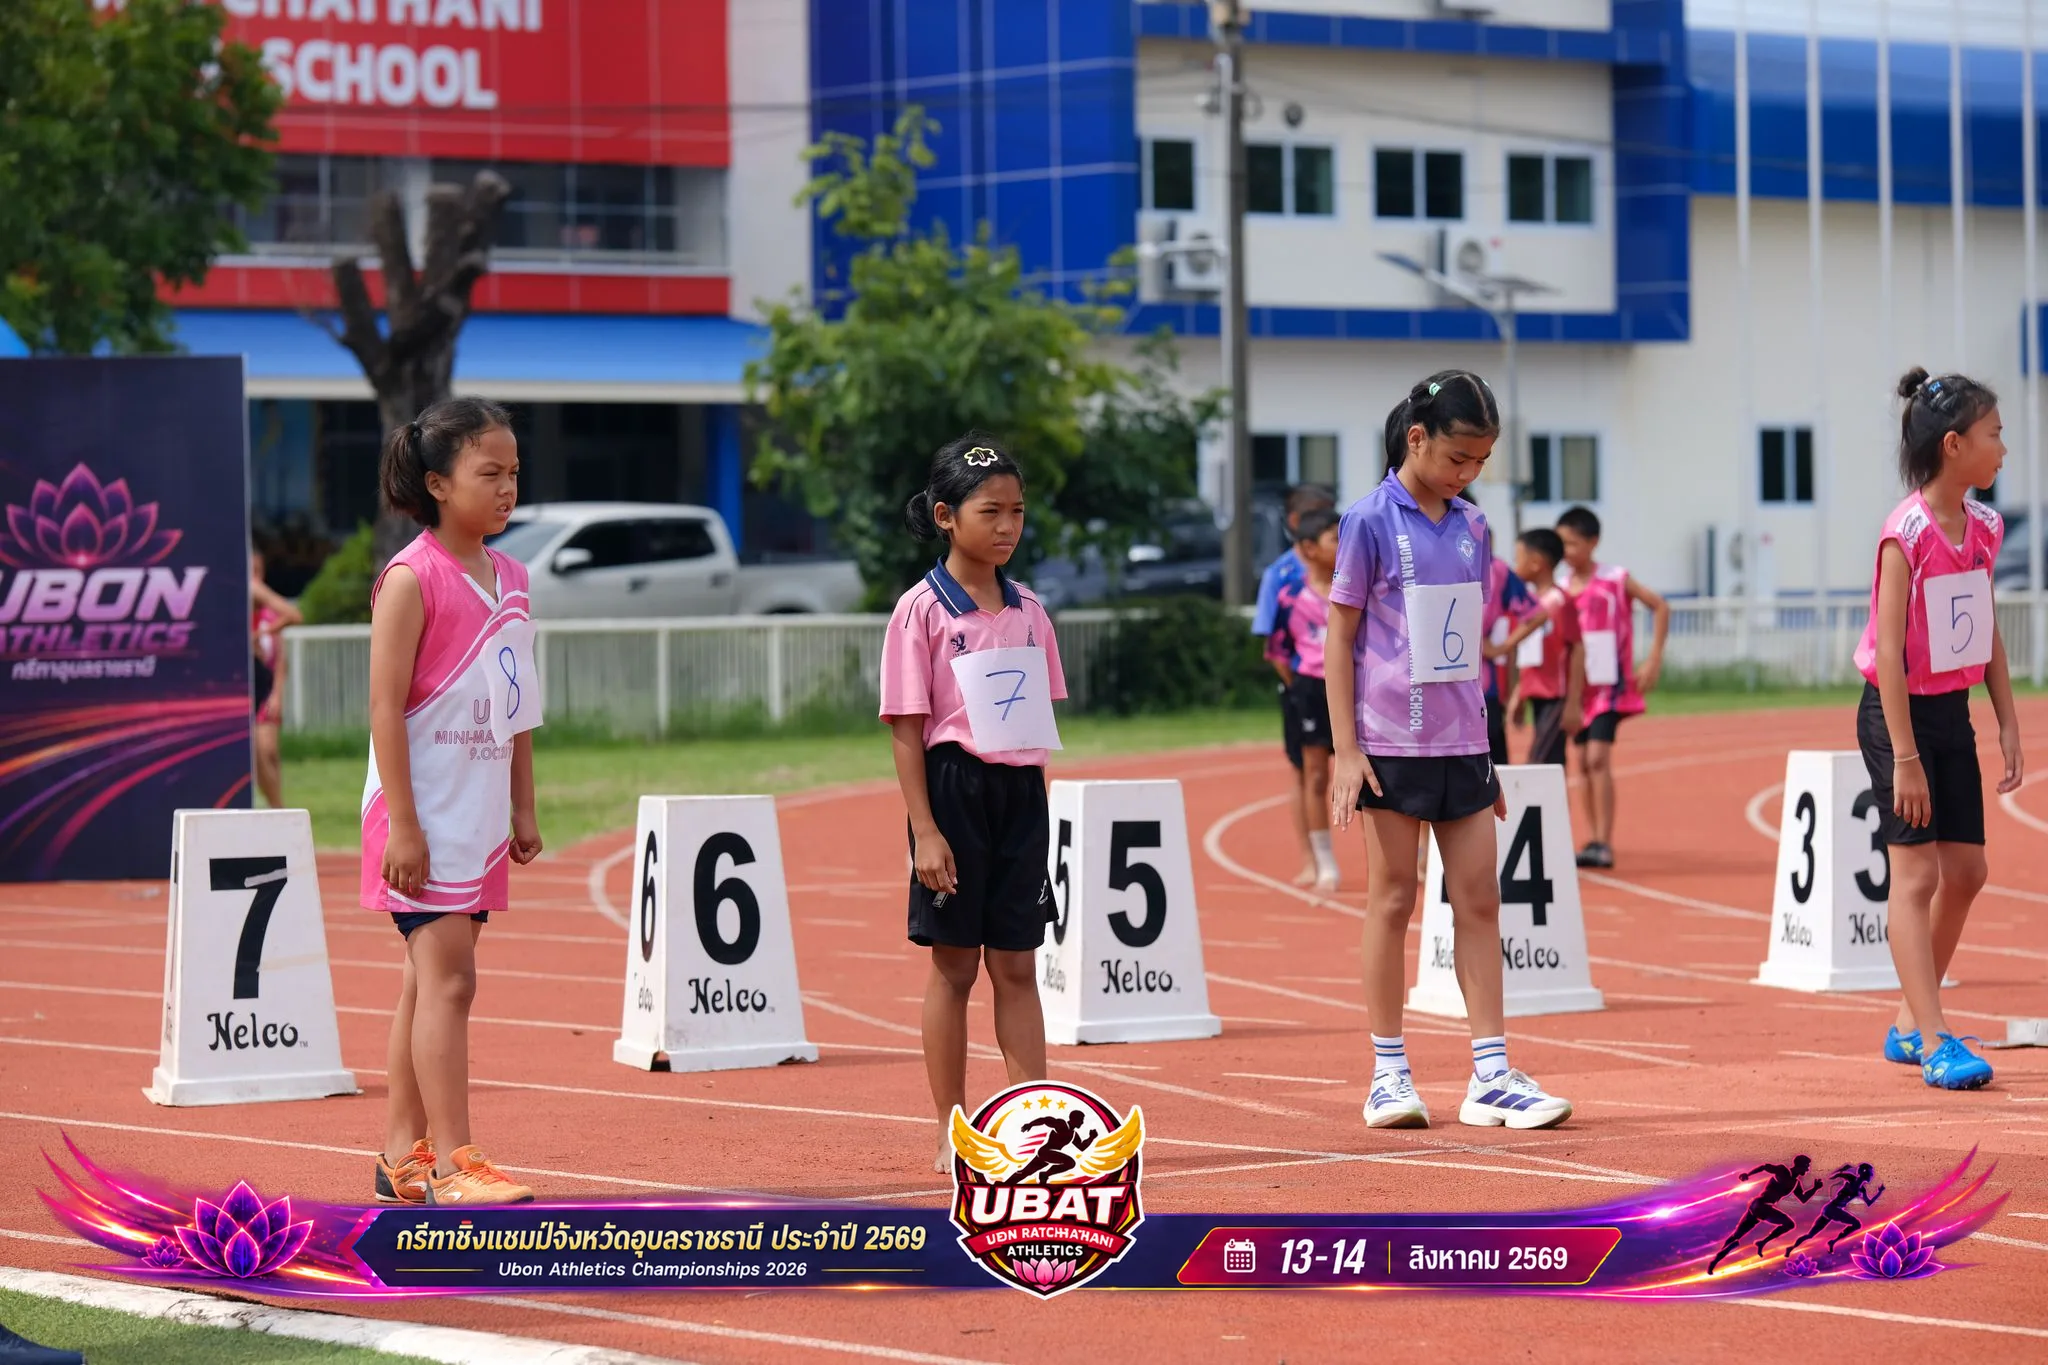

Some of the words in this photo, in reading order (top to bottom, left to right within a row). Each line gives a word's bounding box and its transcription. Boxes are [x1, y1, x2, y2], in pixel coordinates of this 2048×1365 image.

[262, 37, 497, 108] SCHOOL
[1443, 598, 1465, 663] 6
[1951, 594, 1974, 654] 5
[498, 646, 521, 720] 8
[985, 669, 1027, 722] 7
[1409, 687, 1424, 732] SCHOOL
[1500, 806, 1554, 926] 4
[1791, 791, 1816, 904] 3
[641, 830, 657, 963] 6
[693, 832, 761, 966] 6
[1053, 818, 1072, 946] 5
[1107, 821, 1167, 948] 5
[209, 856, 288, 1000] 7
[1781, 912, 1813, 948] Nelco
[1849, 912, 1889, 945] Nel
[688, 978, 767, 1015] Nelco
[1101, 959, 1173, 994] Nelco
[207, 1011, 299, 1051] Nelco
